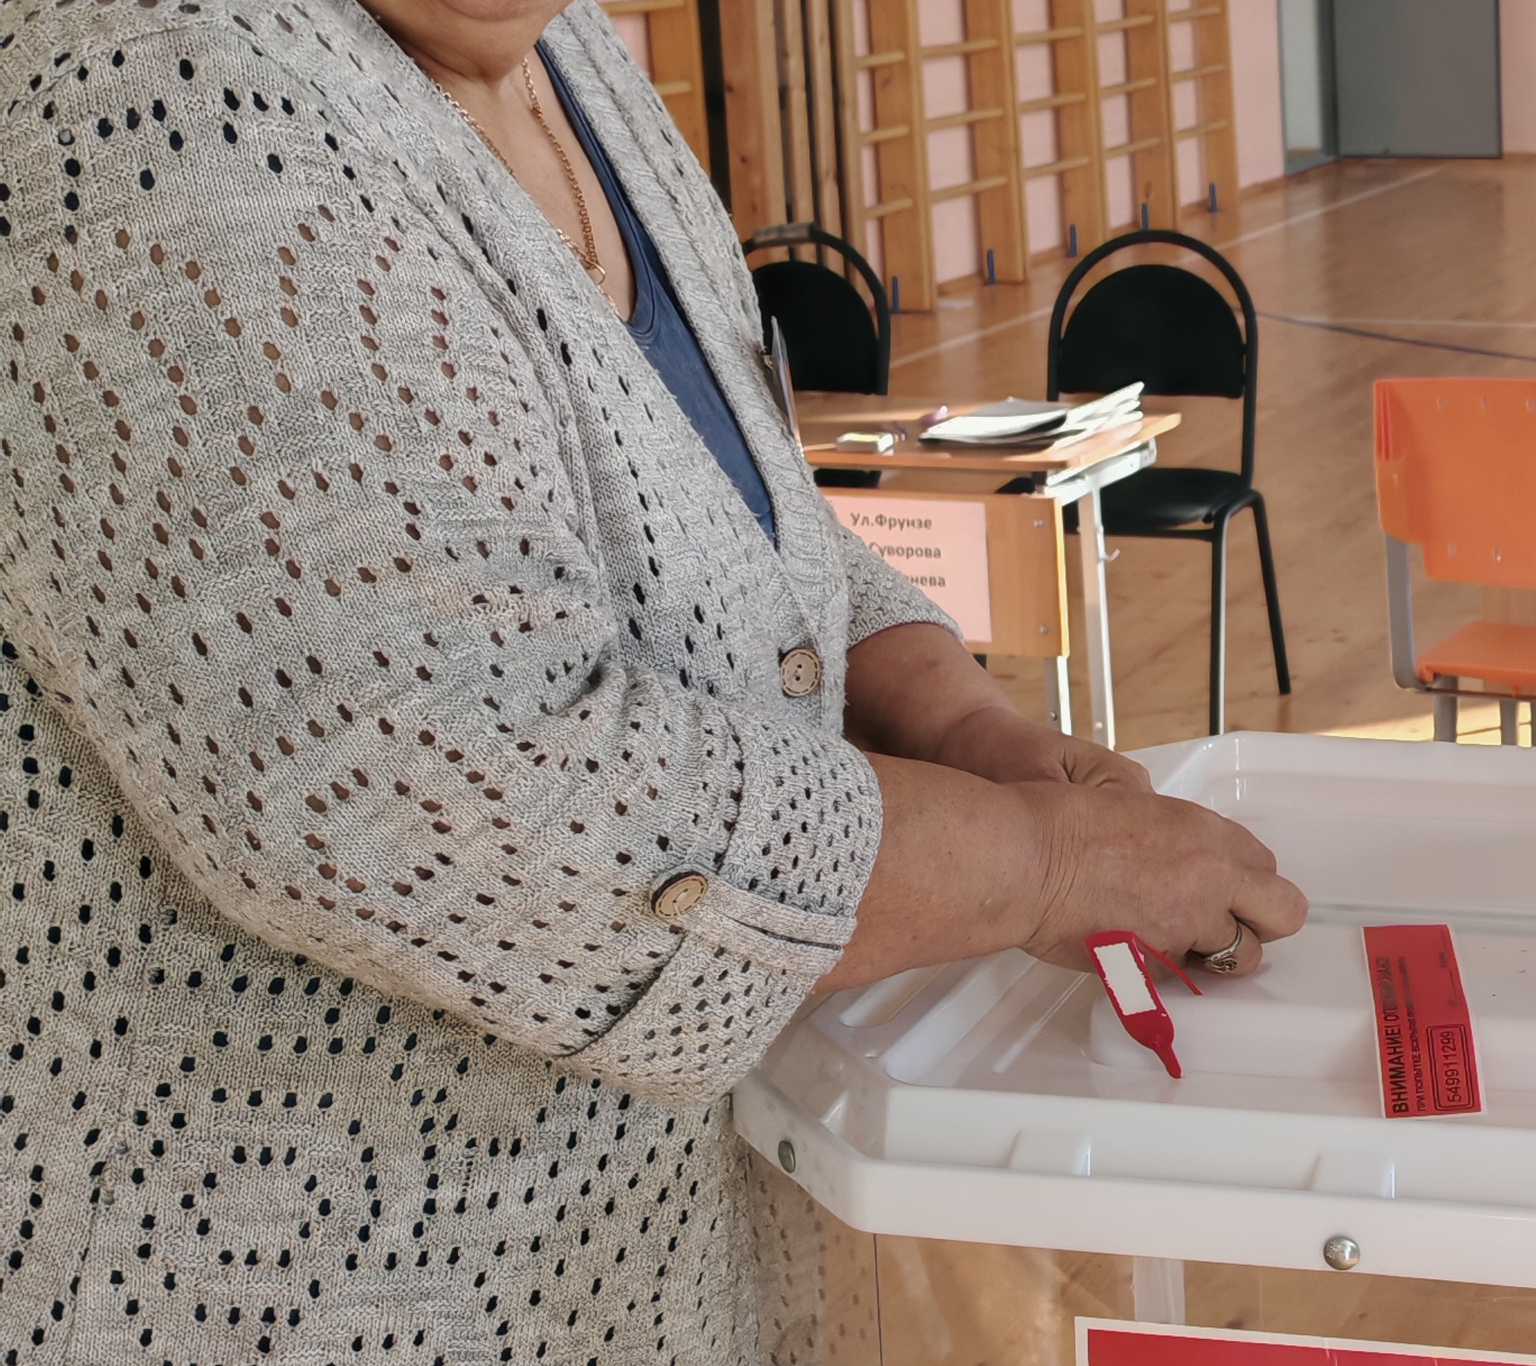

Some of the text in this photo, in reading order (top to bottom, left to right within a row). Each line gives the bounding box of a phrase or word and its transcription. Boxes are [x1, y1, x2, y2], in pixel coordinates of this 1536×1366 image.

[850, 512, 932, 531] Ул.Фрунзе
[1386, 1025, 1409, 1113] ВНИМАНИЕ!
[1440, 1030, 1462, 1103] 549911299
